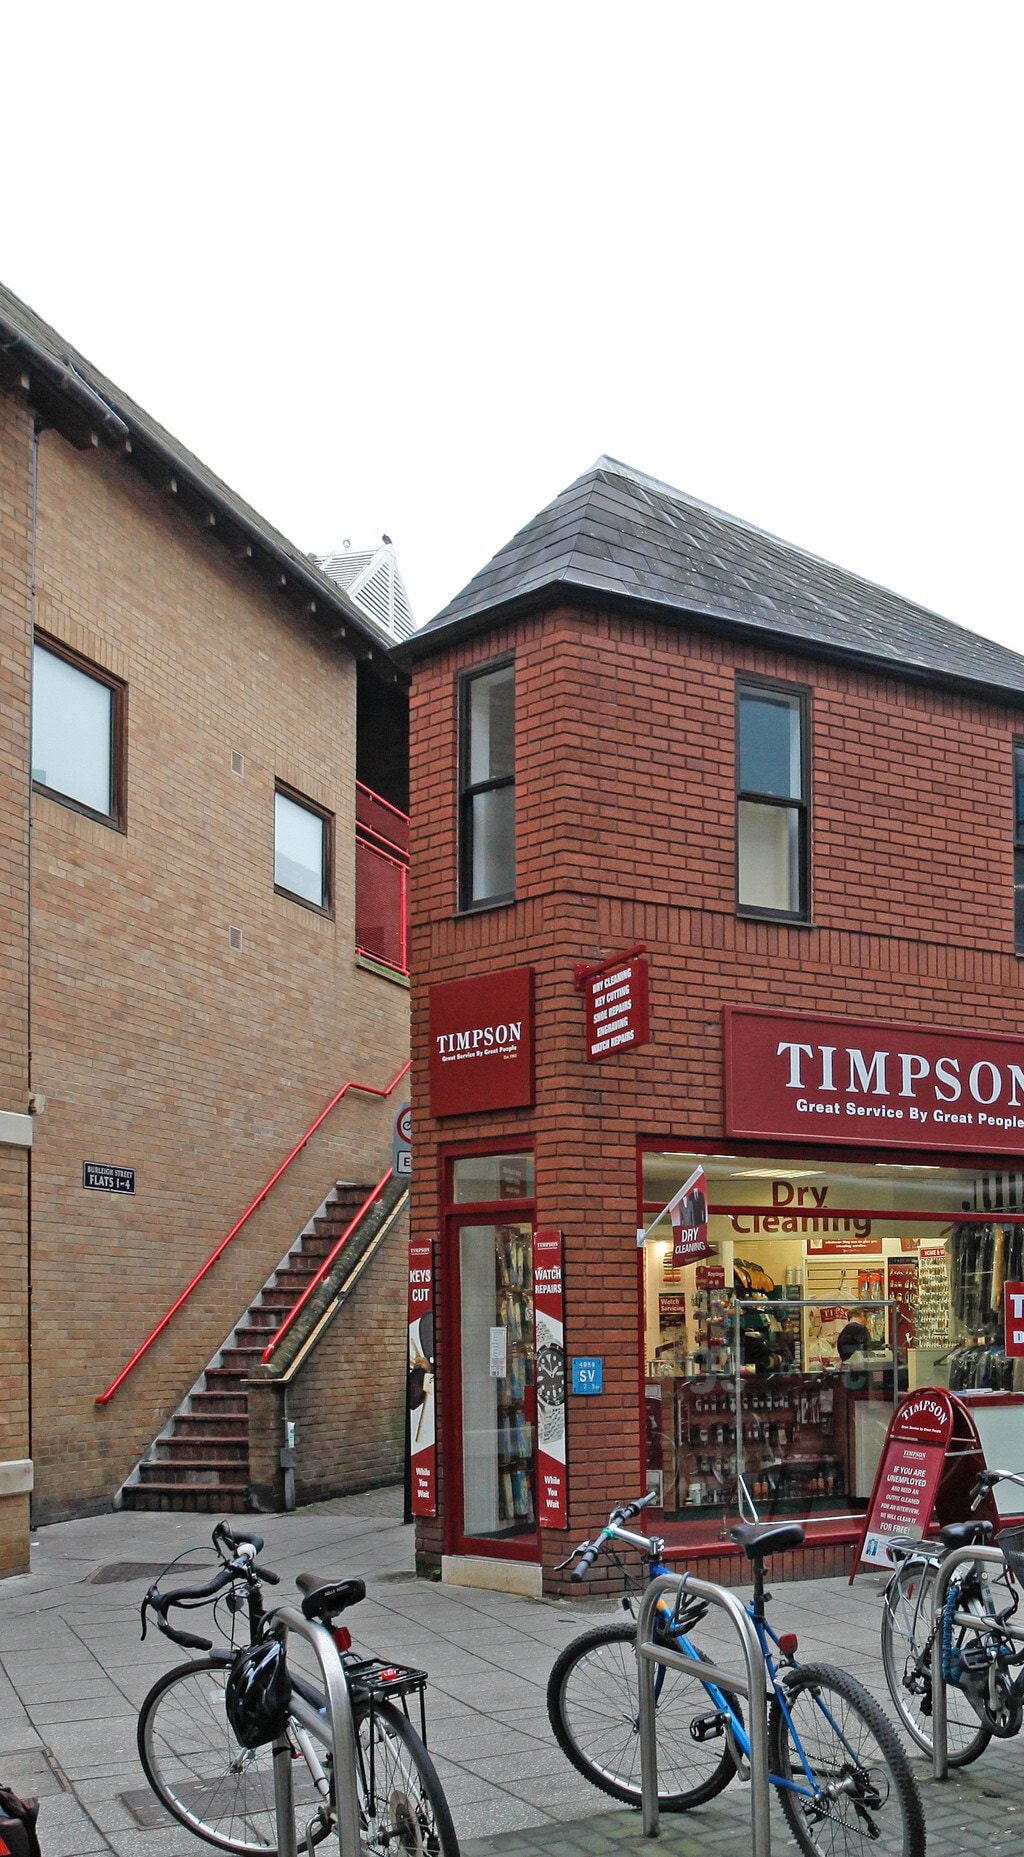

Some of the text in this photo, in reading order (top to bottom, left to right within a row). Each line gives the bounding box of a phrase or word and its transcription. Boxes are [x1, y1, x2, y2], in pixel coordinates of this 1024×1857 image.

[592, 967, 632, 994] DRY CLEANING
[594, 984, 630, 1008] KEY CUTTING
[593, 999, 632, 1024] SHOE REPAIRS
[596, 1016, 629, 1037] ENGRAVING
[436, 1021, 522, 1054] TIMPSON
[591, 1029, 634, 1055] WATCH REPAIRS
[456, 1052, 475, 1060] Service
[484, 1047, 499, 1055] Great
[499, 1045, 517, 1053] People
[796, 1098, 840, 1114] Great
[846, 1102, 904, 1119] Service
[909, 1107, 928, 1123] By
[933, 1109, 973, 1124] Great
[978, 1112, 1024, 1130] People
[114, 1169, 133, 1178] STREET
[90, 1174, 131, 1190] FLATS 1-4
[772, 1181, 829, 1208] Dry
[731, 1207, 872, 1238] Cleaning
[681, 1227, 699, 1243] DRY
[675, 1241, 706, 1254] CLEANING
[410, 1269, 431, 1283] KEYS
[534, 1269, 561, 1280] WATCH
[412, 1288, 430, 1302] CUT
[535, 1284, 562, 1294] REPAIRS
[661, 1305, 684, 1313] Servicing
[579, 1369, 596, 1383] SV
[901, 1400, 948, 1425] TIMPSON
[903, 1450, 926, 1458] TIMPSON
[415, 1467, 431, 1476] While
[893, 1465, 926, 1478] IF YOU ARE
[418, 1478, 428, 1487] You
[543, 1475, 561, 1485] While
[887, 1474, 927, 1487] UNEMPLOYED
[417, 1490, 430, 1498] Wait
[547, 1487, 558, 1497] You
[545, 1499, 560, 1509] Wait
[900, 1496, 920, 1505] CLEANED
[880, 1522, 910, 1535] FOR FREE!
